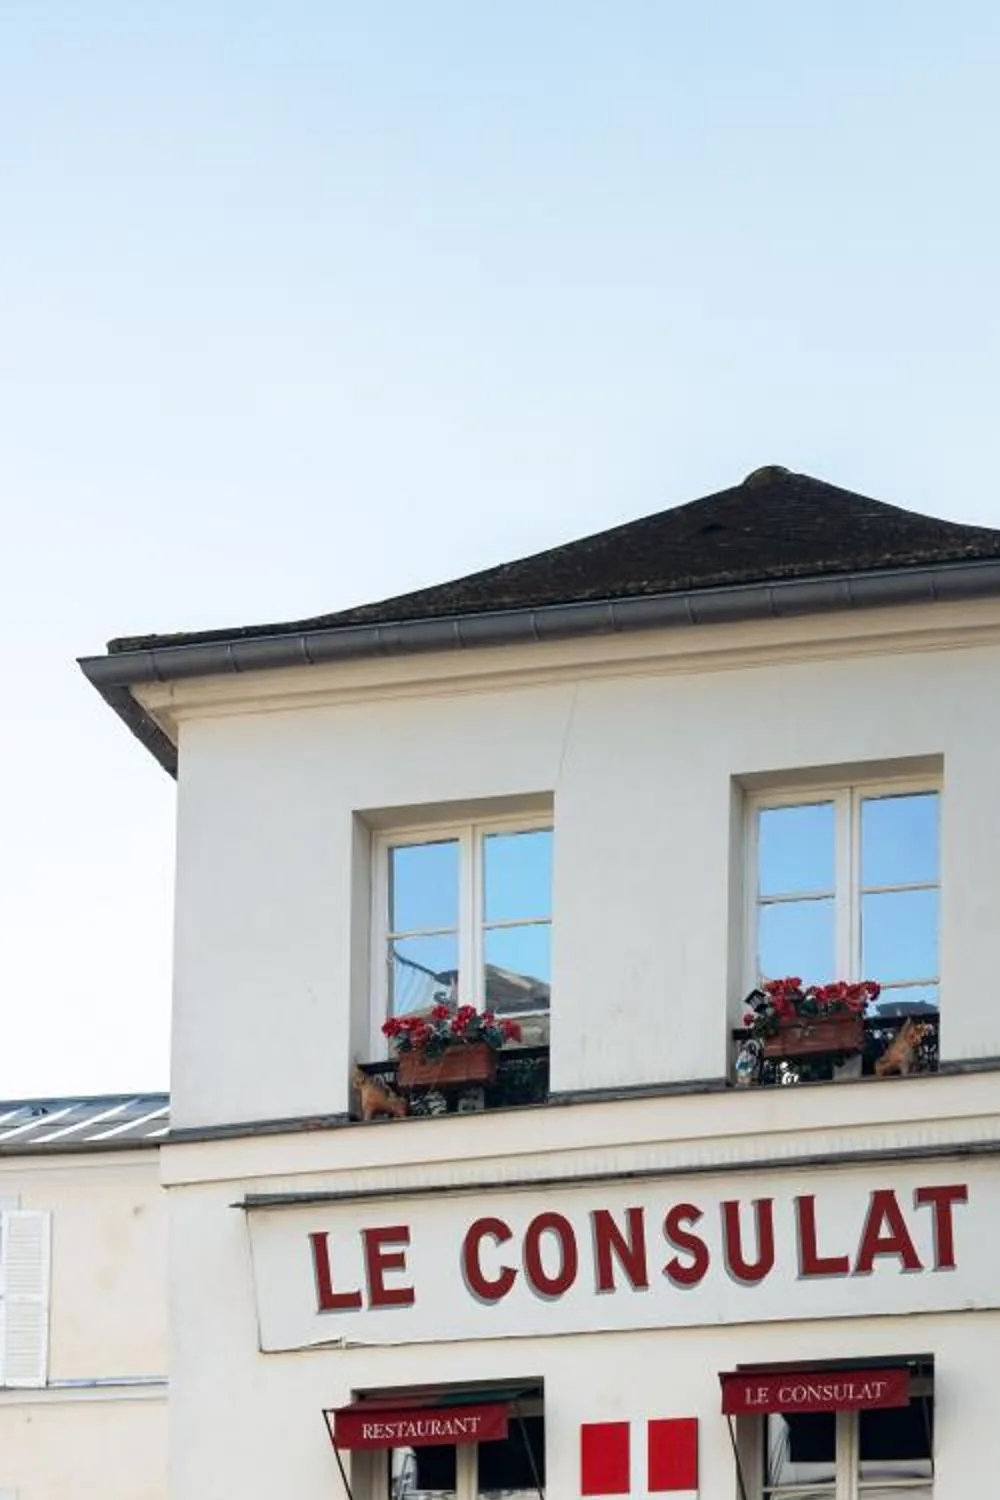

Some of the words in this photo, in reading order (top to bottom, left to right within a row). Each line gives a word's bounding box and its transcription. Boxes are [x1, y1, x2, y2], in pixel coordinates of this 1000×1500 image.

[310, 1225, 416, 1312] LE
[462, 1184, 968, 1302] CONSULAT
[745, 1385, 770, 1405] LE
[778, 1379, 887, 1403] CONSULAT
[361, 1415, 482, 1441] RESTAURANT
